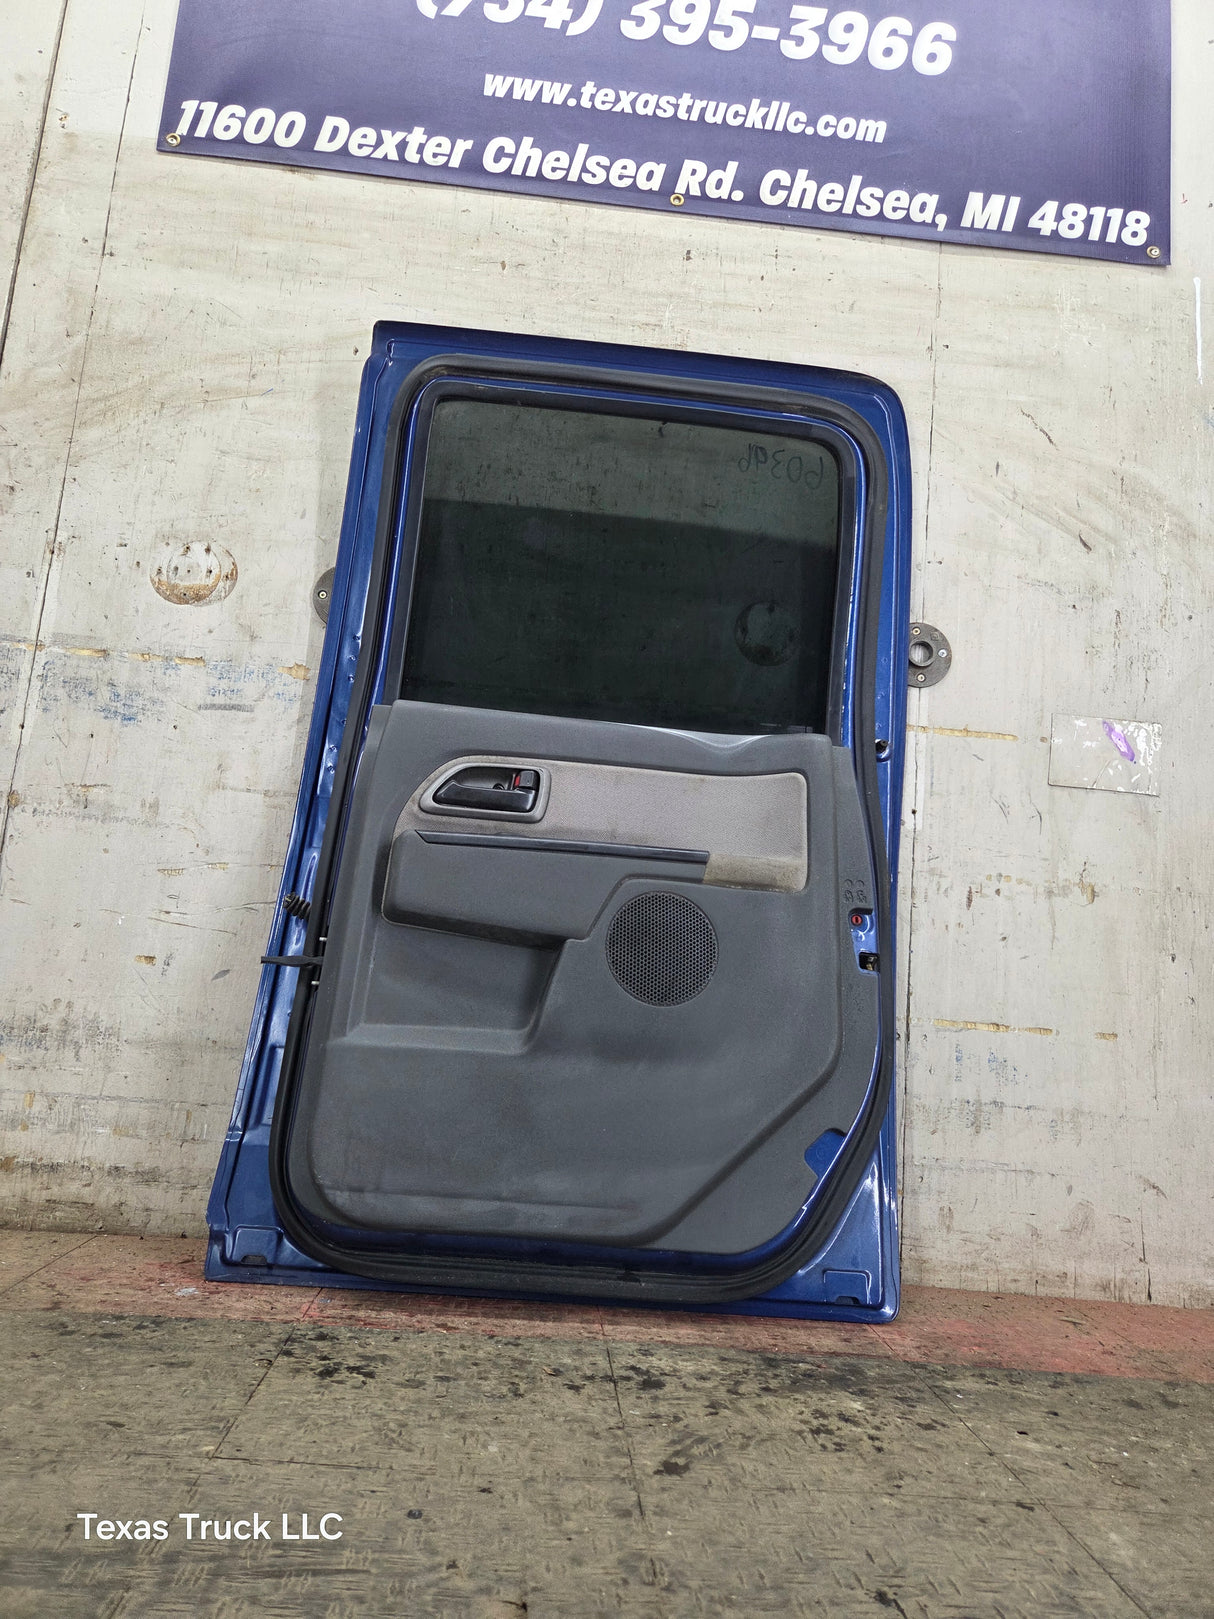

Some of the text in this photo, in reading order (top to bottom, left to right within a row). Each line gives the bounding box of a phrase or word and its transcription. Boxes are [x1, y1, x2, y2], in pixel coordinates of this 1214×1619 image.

[619, 0, 957, 76] 395-3966
[483, 73, 887, 143] www.texastruckllc.com
[175, 99, 1151, 246] 11600 Dexter Chelsea Rd. Chelsea, MI 48118
